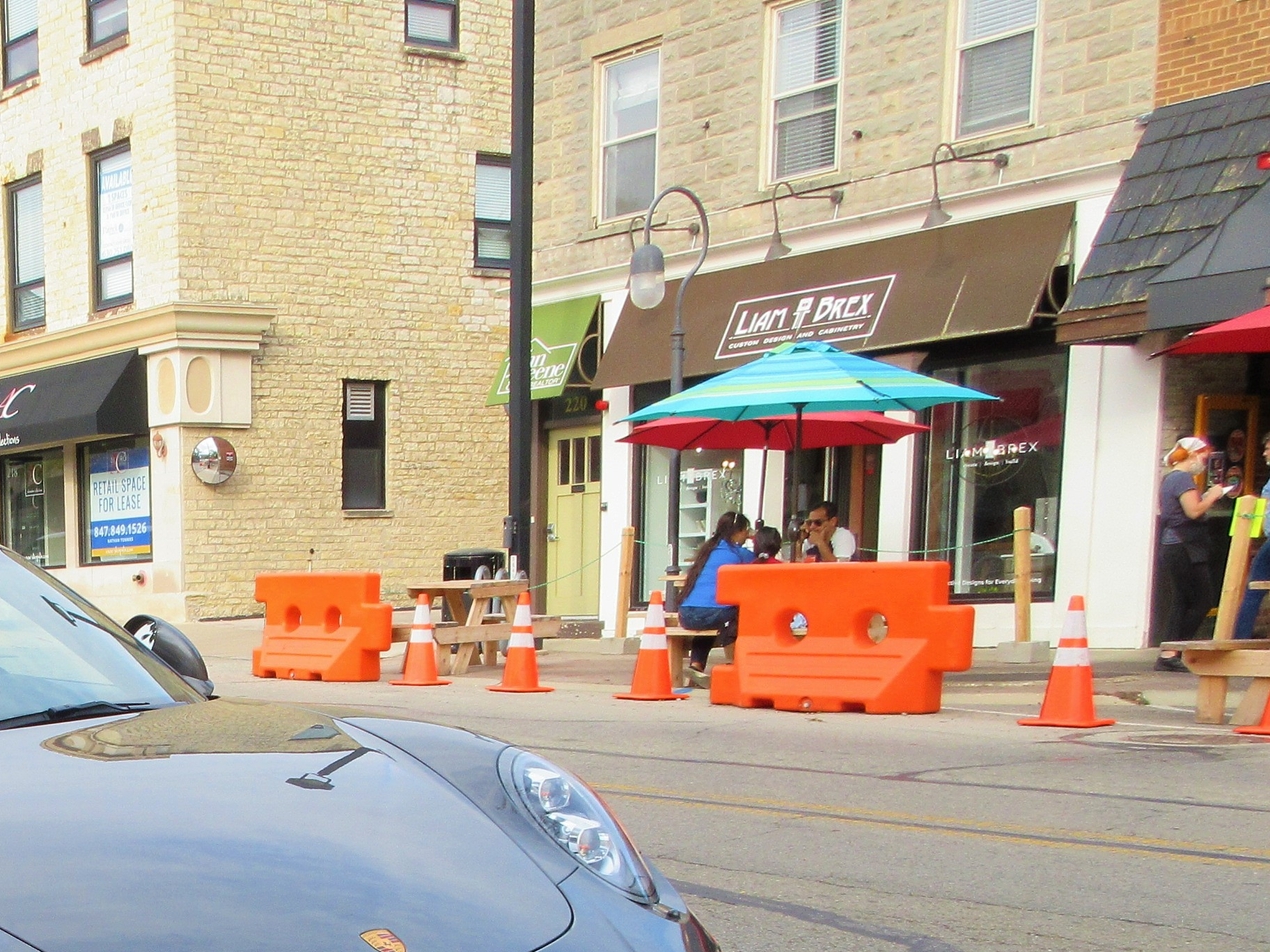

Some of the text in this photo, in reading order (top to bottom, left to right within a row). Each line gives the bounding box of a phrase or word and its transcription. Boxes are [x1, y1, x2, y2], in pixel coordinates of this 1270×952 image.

[734, 292, 875, 336] LIAM BREX
[728, 322, 865, 350] CUSTOM DESIGN AND CABINETRY
[565, 395, 588, 413] 220
[996, 441, 1039, 455] BREX
[93, 475, 146, 496] RETAIL SPACE
[657, 471, 687, 485] LIM
[98, 493, 141, 513] FOR LEASE
[93, 522, 147, 538] 847.849.1526
